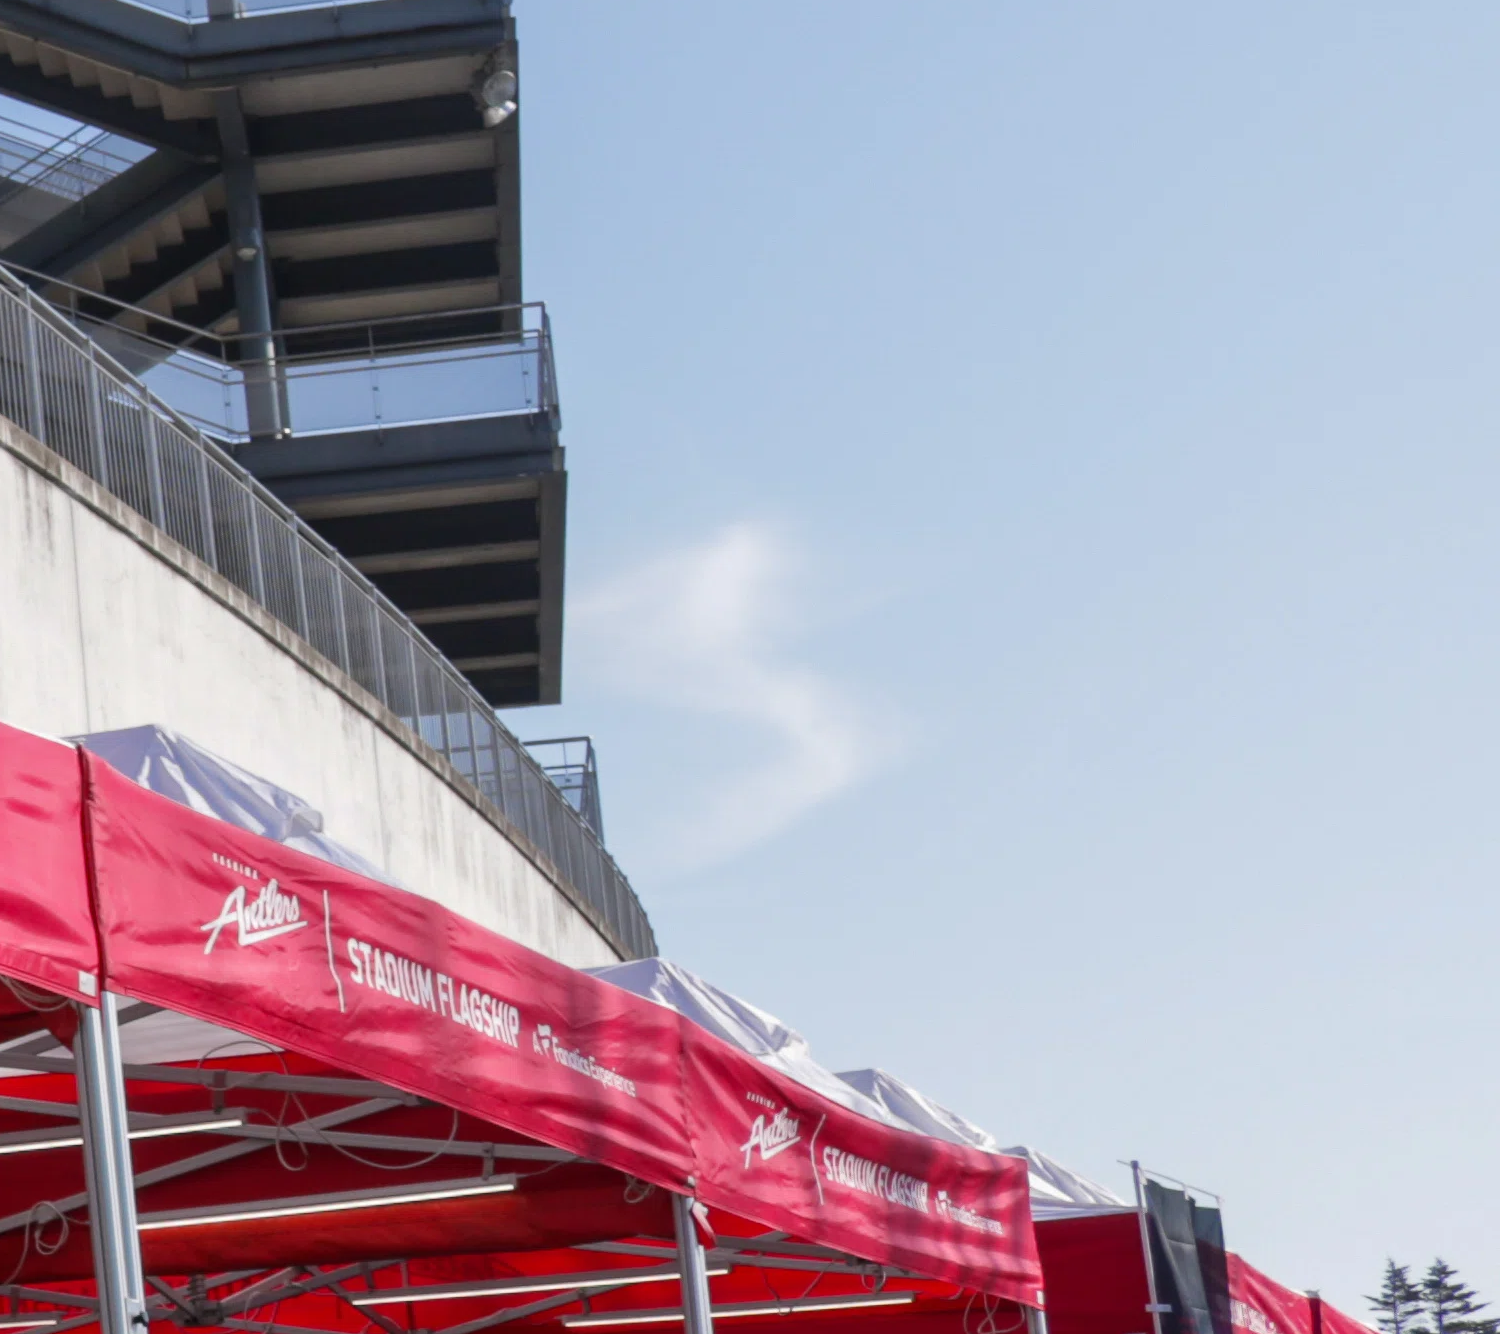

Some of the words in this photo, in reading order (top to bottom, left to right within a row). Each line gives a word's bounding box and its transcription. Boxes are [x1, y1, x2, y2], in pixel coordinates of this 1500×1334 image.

[200, 878, 309, 955] Antlers
[346, 937, 436, 1014] STADIUM
[436, 972, 521, 1048] FLAGSHIP
[823, 1145, 879, 1197] STADIUM
[877, 1165, 930, 1214] FLAGSHIP
